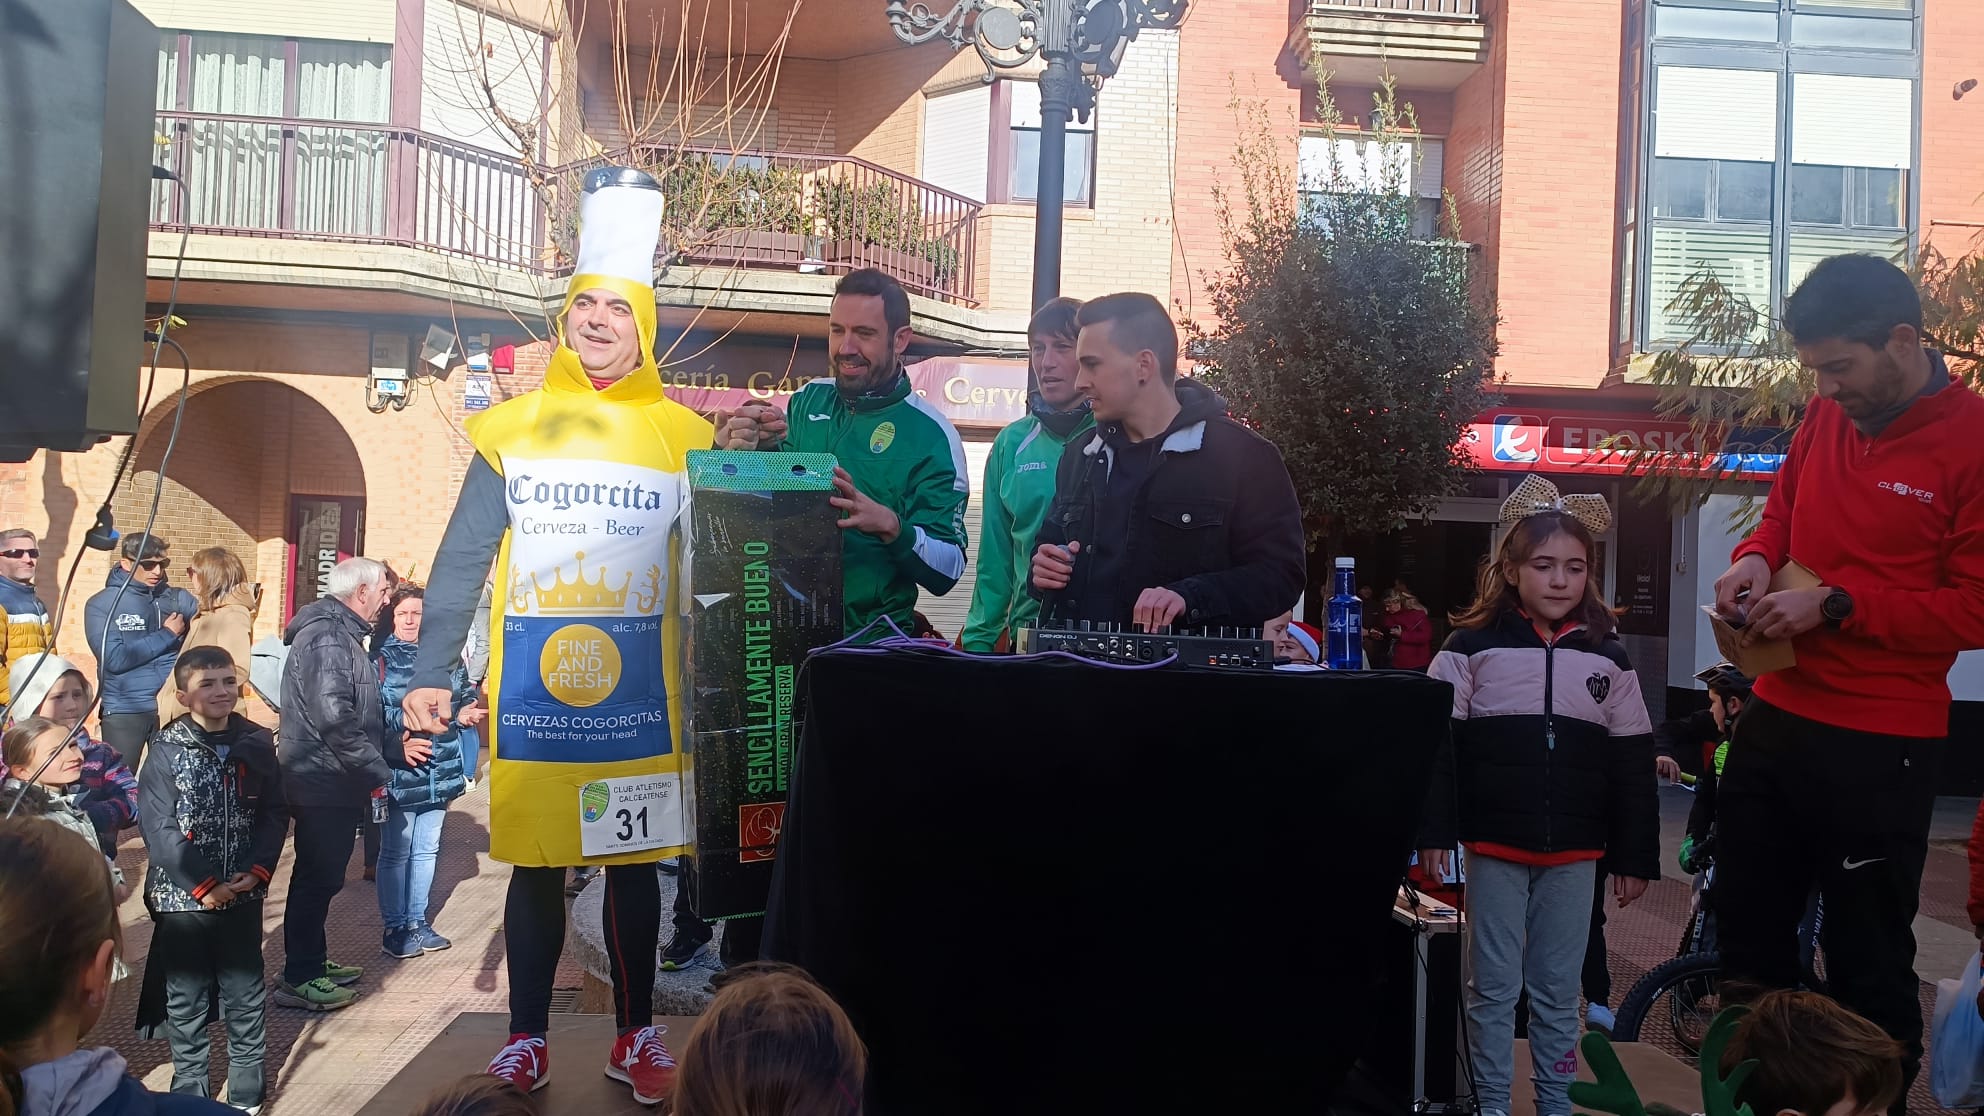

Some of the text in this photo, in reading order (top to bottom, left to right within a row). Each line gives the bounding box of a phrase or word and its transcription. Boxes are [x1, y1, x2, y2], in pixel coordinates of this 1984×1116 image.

[508, 474, 662, 511] Cogorcita
[521, 516, 588, 535] Cerveza
[606, 519, 645, 537] Beer
[505, 621, 526, 632] 33 cl.
[612, 623, 632, 633] alc.
[634, 622, 647, 634] 7,8
[557, 639, 602, 656] FINE
[556, 657, 603, 672] AND
[743, 541, 774, 794] SENCILLAMENTE BUENO
[549, 672, 612, 689] FRESH
[779, 668, 792, 715] RESERVA
[502, 710, 662, 729] CERVEZAS COGORCITAS
[527, 729, 638, 743] The best for your head
[613, 785, 634, 794] CLUB
[635, 781, 672, 791] ATLETISMO
[618, 790, 669, 803] CALCEATENSE
[615, 806, 649, 841] 31
